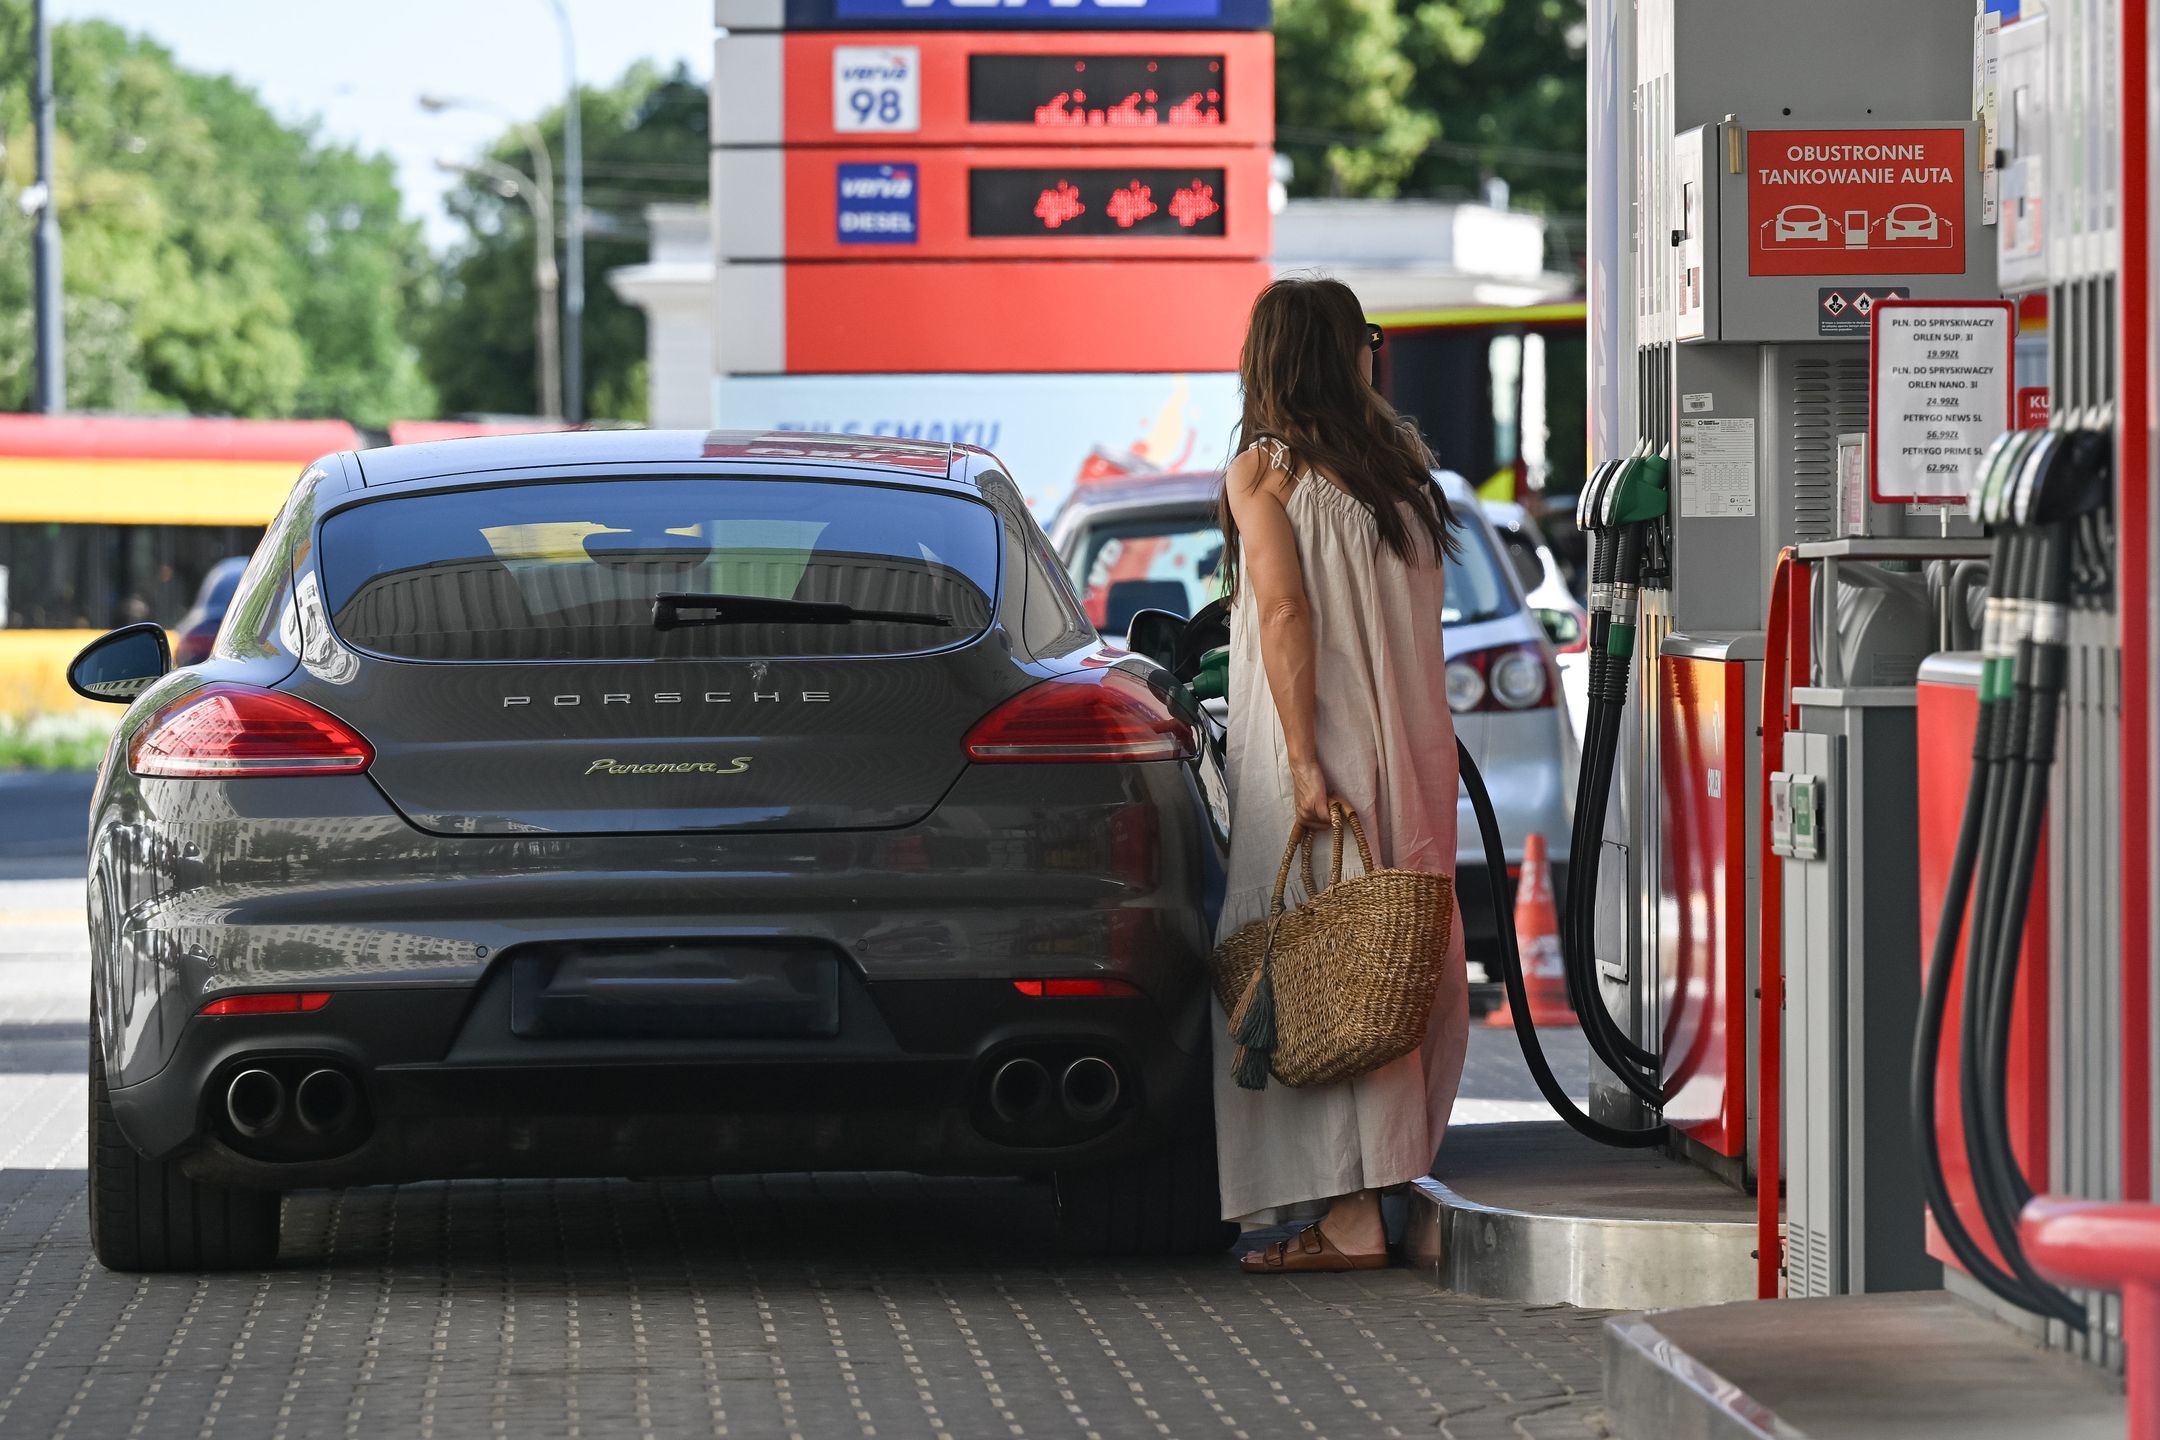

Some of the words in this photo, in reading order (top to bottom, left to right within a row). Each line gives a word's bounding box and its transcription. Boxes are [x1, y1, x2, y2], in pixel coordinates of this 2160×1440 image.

[850, 88, 902, 124] 98
[1787, 145, 1924, 161] OBUSTRONNE
[1759, 168, 1894, 184] TANKOWANIE
[1900, 167, 1953, 183] AUTA
[839, 211, 914, 233] DIESEL
[1914, 319, 1927, 327] DO
[1929, 319, 1994, 327] SPRYSKIWACZY
[1913, 333, 1941, 341] ORLEN
[1943, 333, 1962, 341] SUP.
[1914, 366, 1927, 374] DO
[1929, 366, 1994, 375] SPRYSKIWACZY
[1908, 380, 1937, 389] ORLEN
[1939, 380, 1968, 389] NANO.
[1903, 414, 1943, 422] PETRYGO
[1902, 447, 1942, 455] PETRYGO
[1944, 447, 1972, 455] PRIME
[503, 691, 831, 707] PORSCHE
[584, 758, 717, 775] Panamera
[716, 756, 753, 774] S
